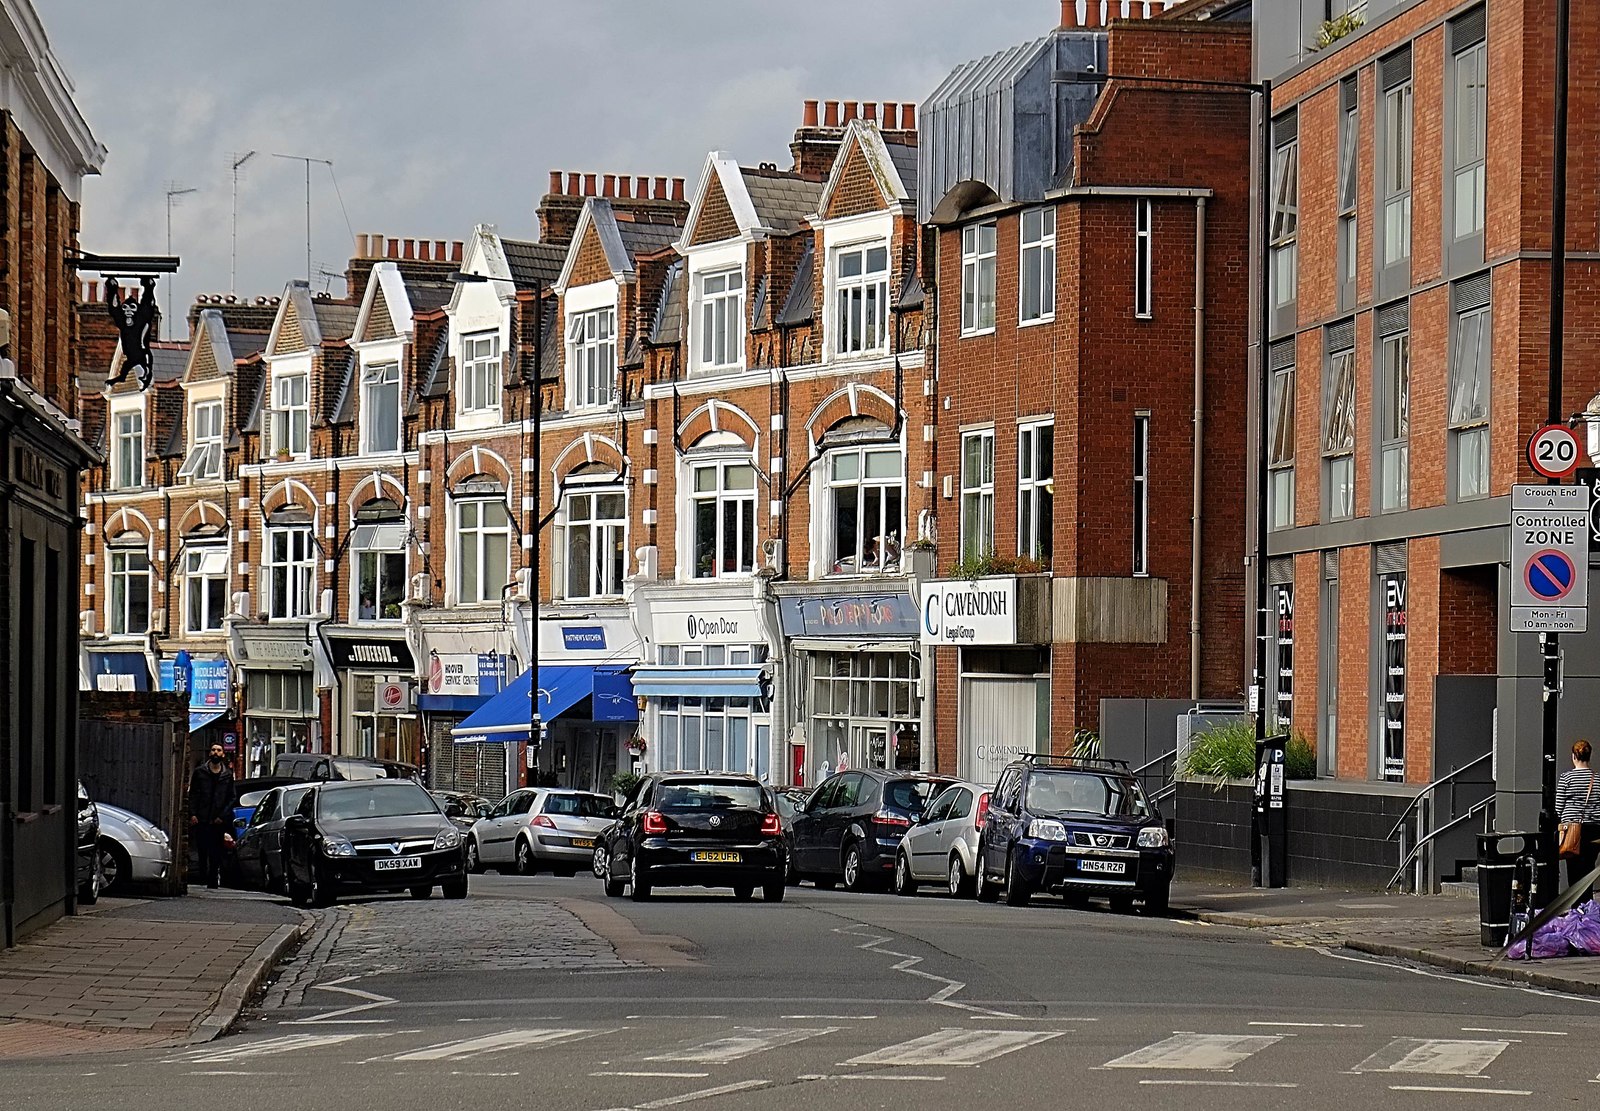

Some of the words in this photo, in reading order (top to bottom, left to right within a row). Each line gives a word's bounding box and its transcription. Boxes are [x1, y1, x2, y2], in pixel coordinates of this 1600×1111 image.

[1538, 440, 1574, 461] 20
[1524, 488, 1556, 497] Crouch
[1560, 489, 1577, 497] End
[1547, 498, 1554, 506] A
[1515, 515, 1586, 527] Controlled
[1525, 531, 1574, 544] ZONE
[945, 590, 1007, 617] CAVENDISH
[1531, 610, 1550, 619] Mon
[1556, 610, 1567, 619] Fri
[698, 617, 720, 640] Open
[720, 617, 738, 634] Door
[1524, 620, 1533, 628] 10
[945, 625, 959, 643] Legal
[960, 625, 975, 642] Group
[213, 666, 227, 677] LANE
[444, 664, 464, 674] HOOVER
[194, 679, 208, 689] FOOD
[213, 679, 227, 689] WINE
[445, 675, 461, 686] SERVICE
[462, 675, 479, 686] CENTRE
[989, 745, 1029, 754] CAVENDISH
[1274, 749, 1284, 762] P
[695, 852, 719, 861] EJ62
[721, 852, 738, 861] UFR
[378, 859, 400, 869] DK59
[1082, 860, 1105, 871] HN54
[1106, 862, 1124, 872] RZR
